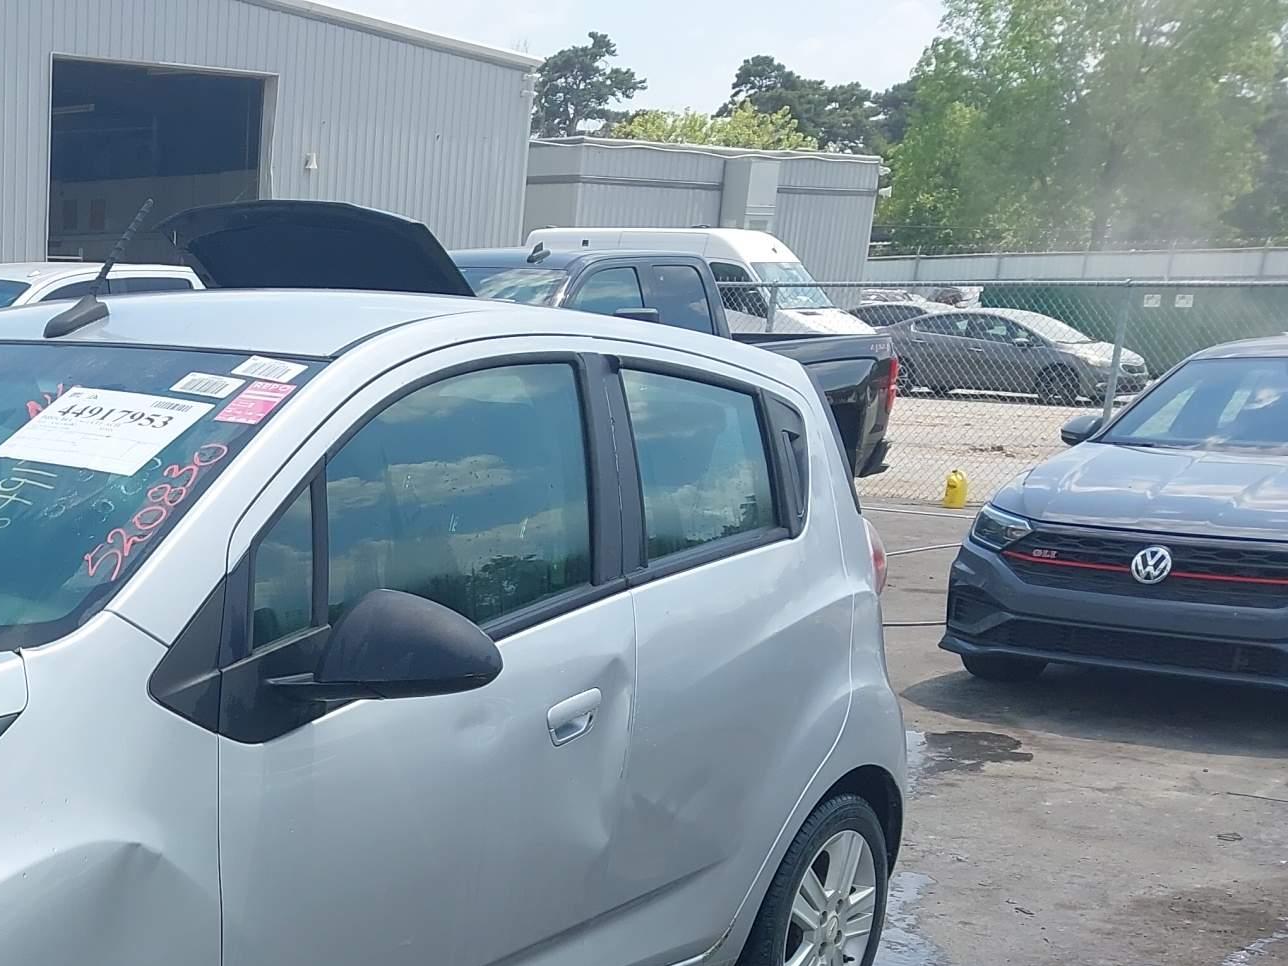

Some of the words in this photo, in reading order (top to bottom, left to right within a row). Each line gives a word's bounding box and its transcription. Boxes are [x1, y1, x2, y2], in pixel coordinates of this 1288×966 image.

[253, 382, 291, 392] REPO
[58, 403, 175, 429] 44917953
[83, 443, 229, 581] 520830
